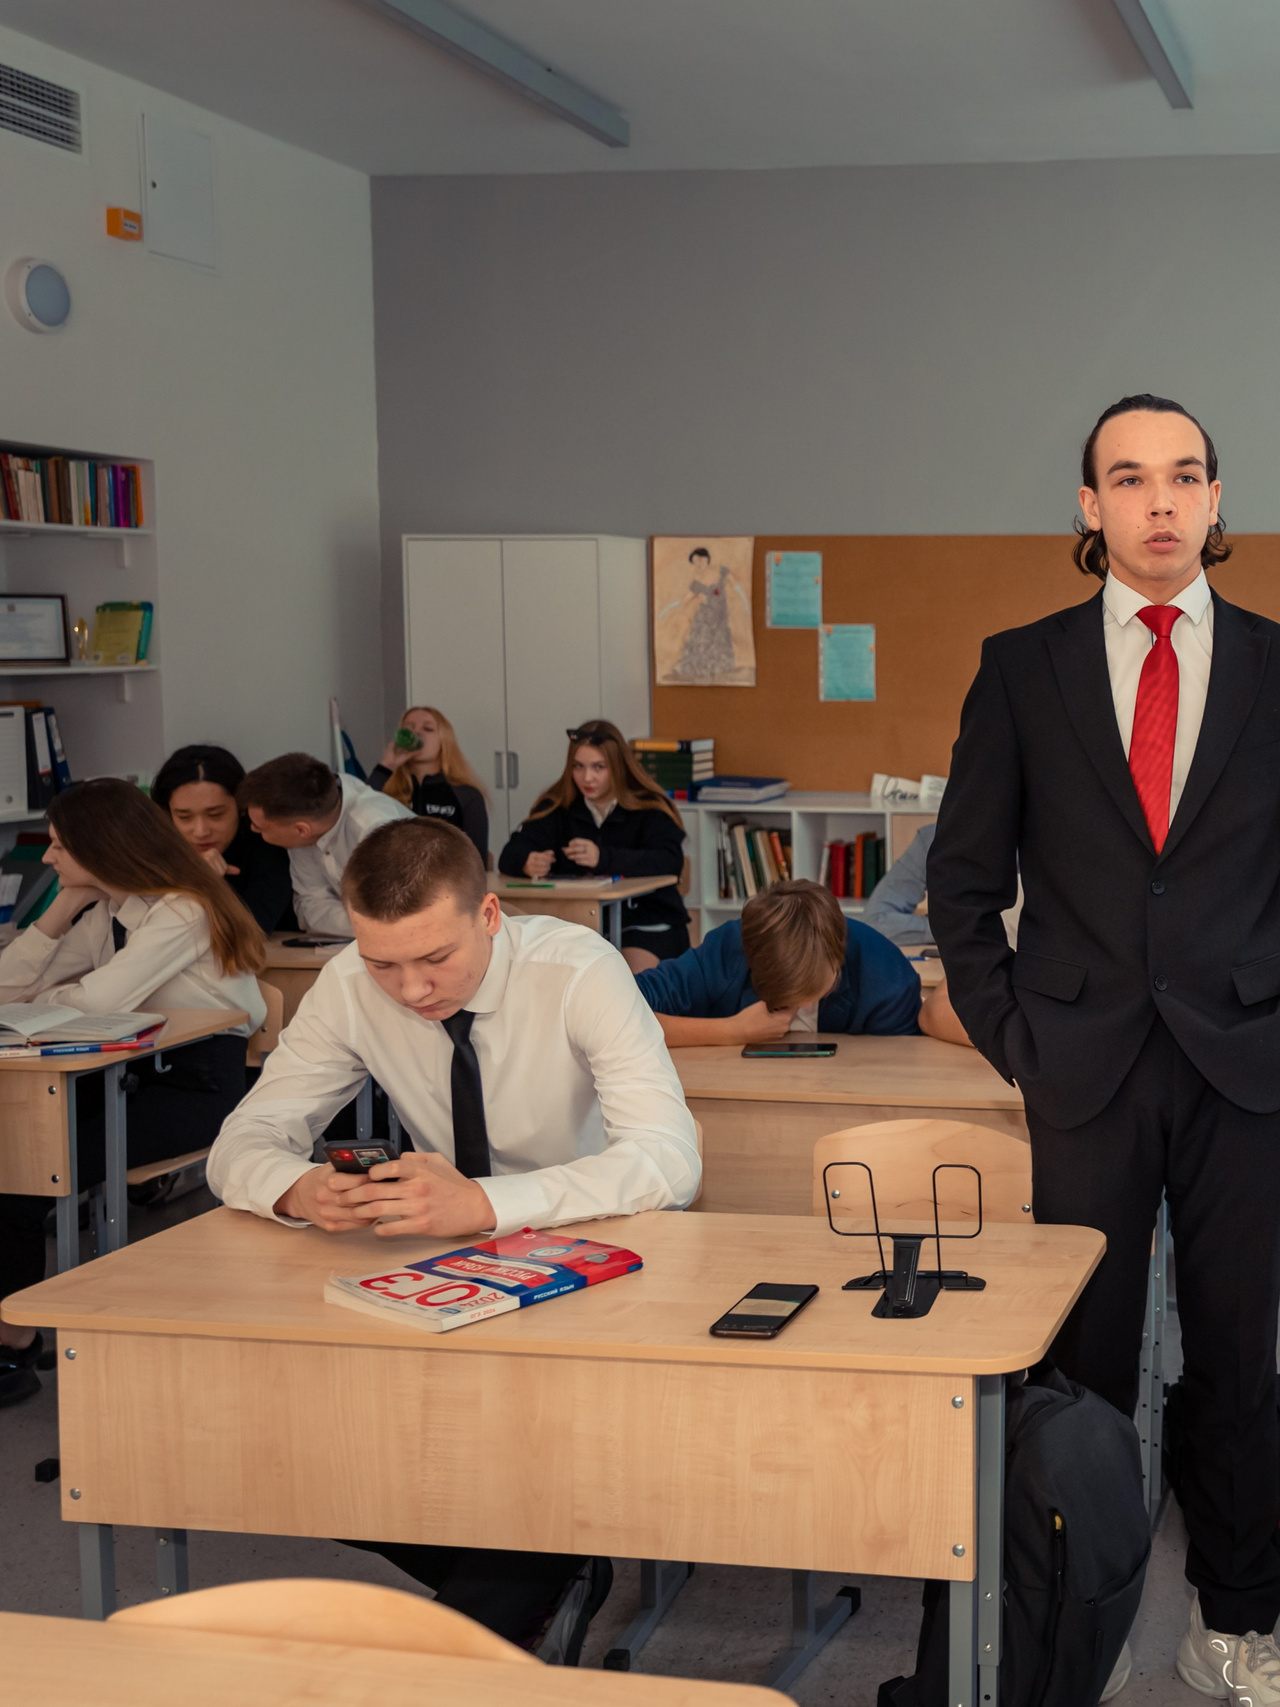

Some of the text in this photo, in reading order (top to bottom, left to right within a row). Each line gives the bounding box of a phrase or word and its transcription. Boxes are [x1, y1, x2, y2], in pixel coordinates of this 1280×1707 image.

[359, 1272, 481, 1308] ОГЭ
[533, 1283, 575, 1300] РУССКИЙ ЯЗЫК
[460, 1291, 505, 1308] 2024
